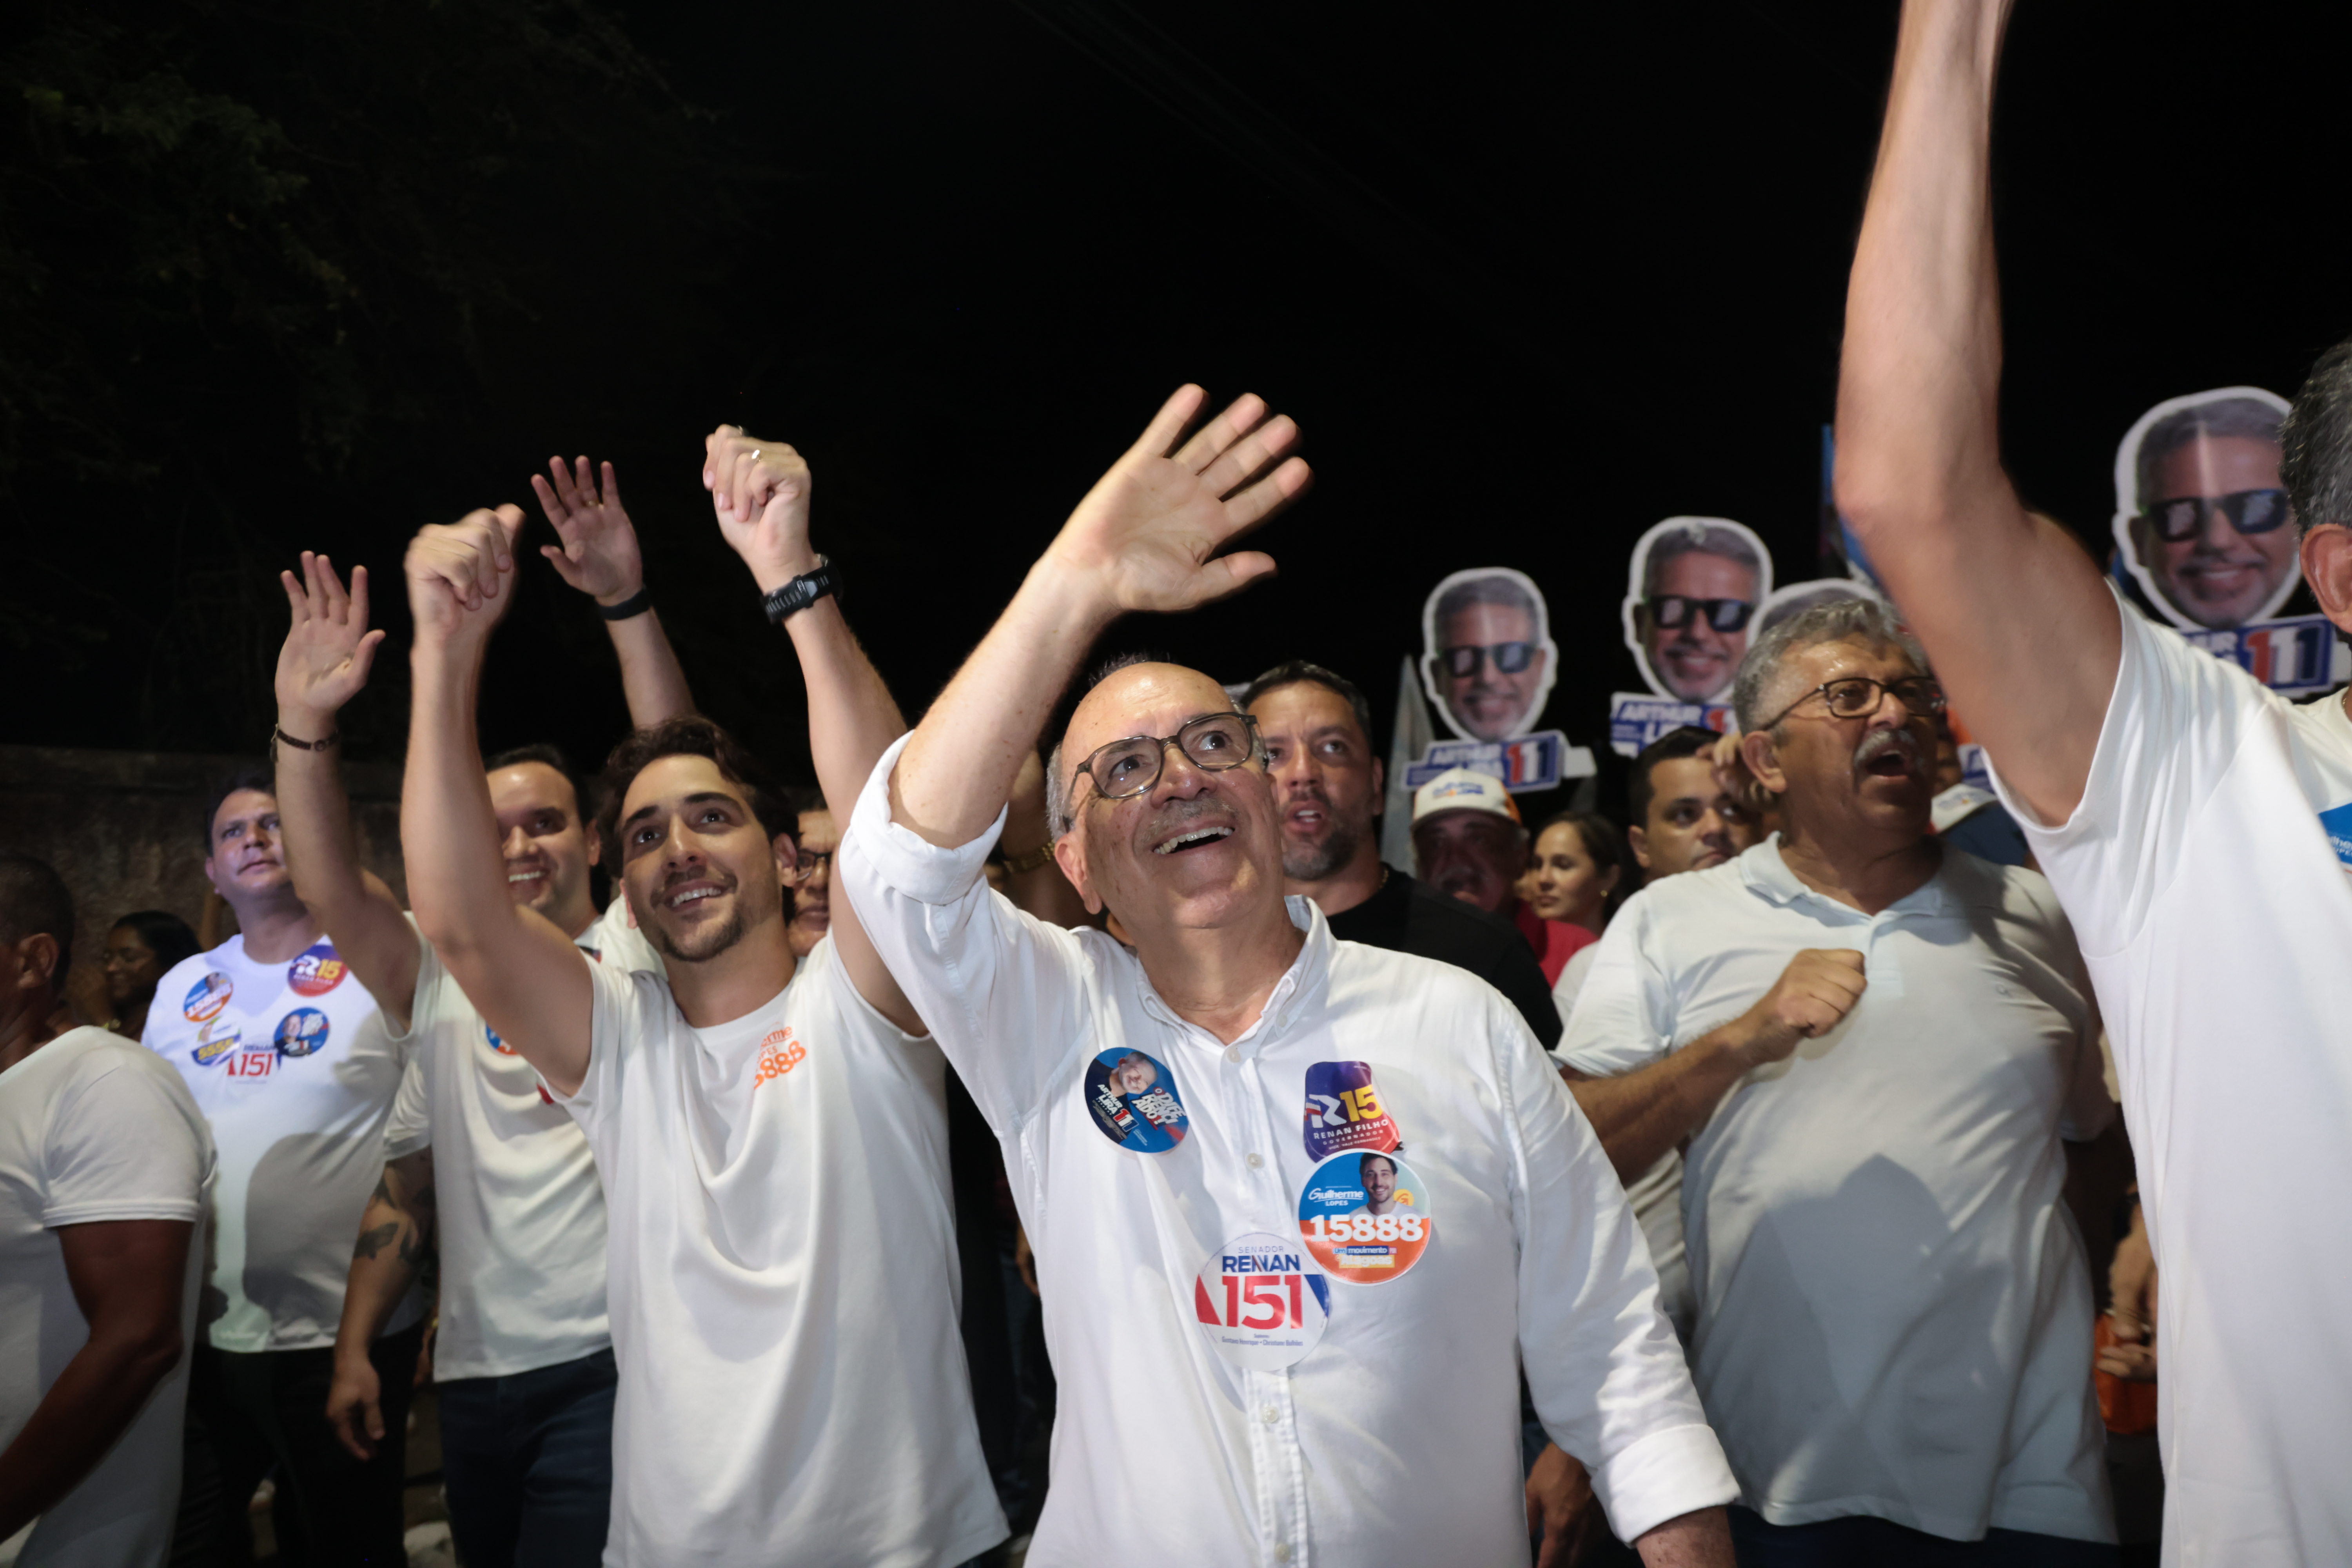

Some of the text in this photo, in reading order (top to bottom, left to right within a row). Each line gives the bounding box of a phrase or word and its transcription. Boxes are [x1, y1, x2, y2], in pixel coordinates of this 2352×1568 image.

[240, 1053, 274, 1077] 151
[1097, 1084, 1123, 1109] ARTHUR
[1098, 1094, 1119, 1114] LIRA
[1313, 1119, 1389, 1140] RENAN FILHO
[1323, 1129, 1384, 1145] GOVERNADOR
[1308, 1187, 1364, 1201] Guilherme
[1309, 1213, 1424, 1242] 15888
[1222, 1254, 1301, 1273] RENAN
[1221, 1274, 1303, 1330] 151
